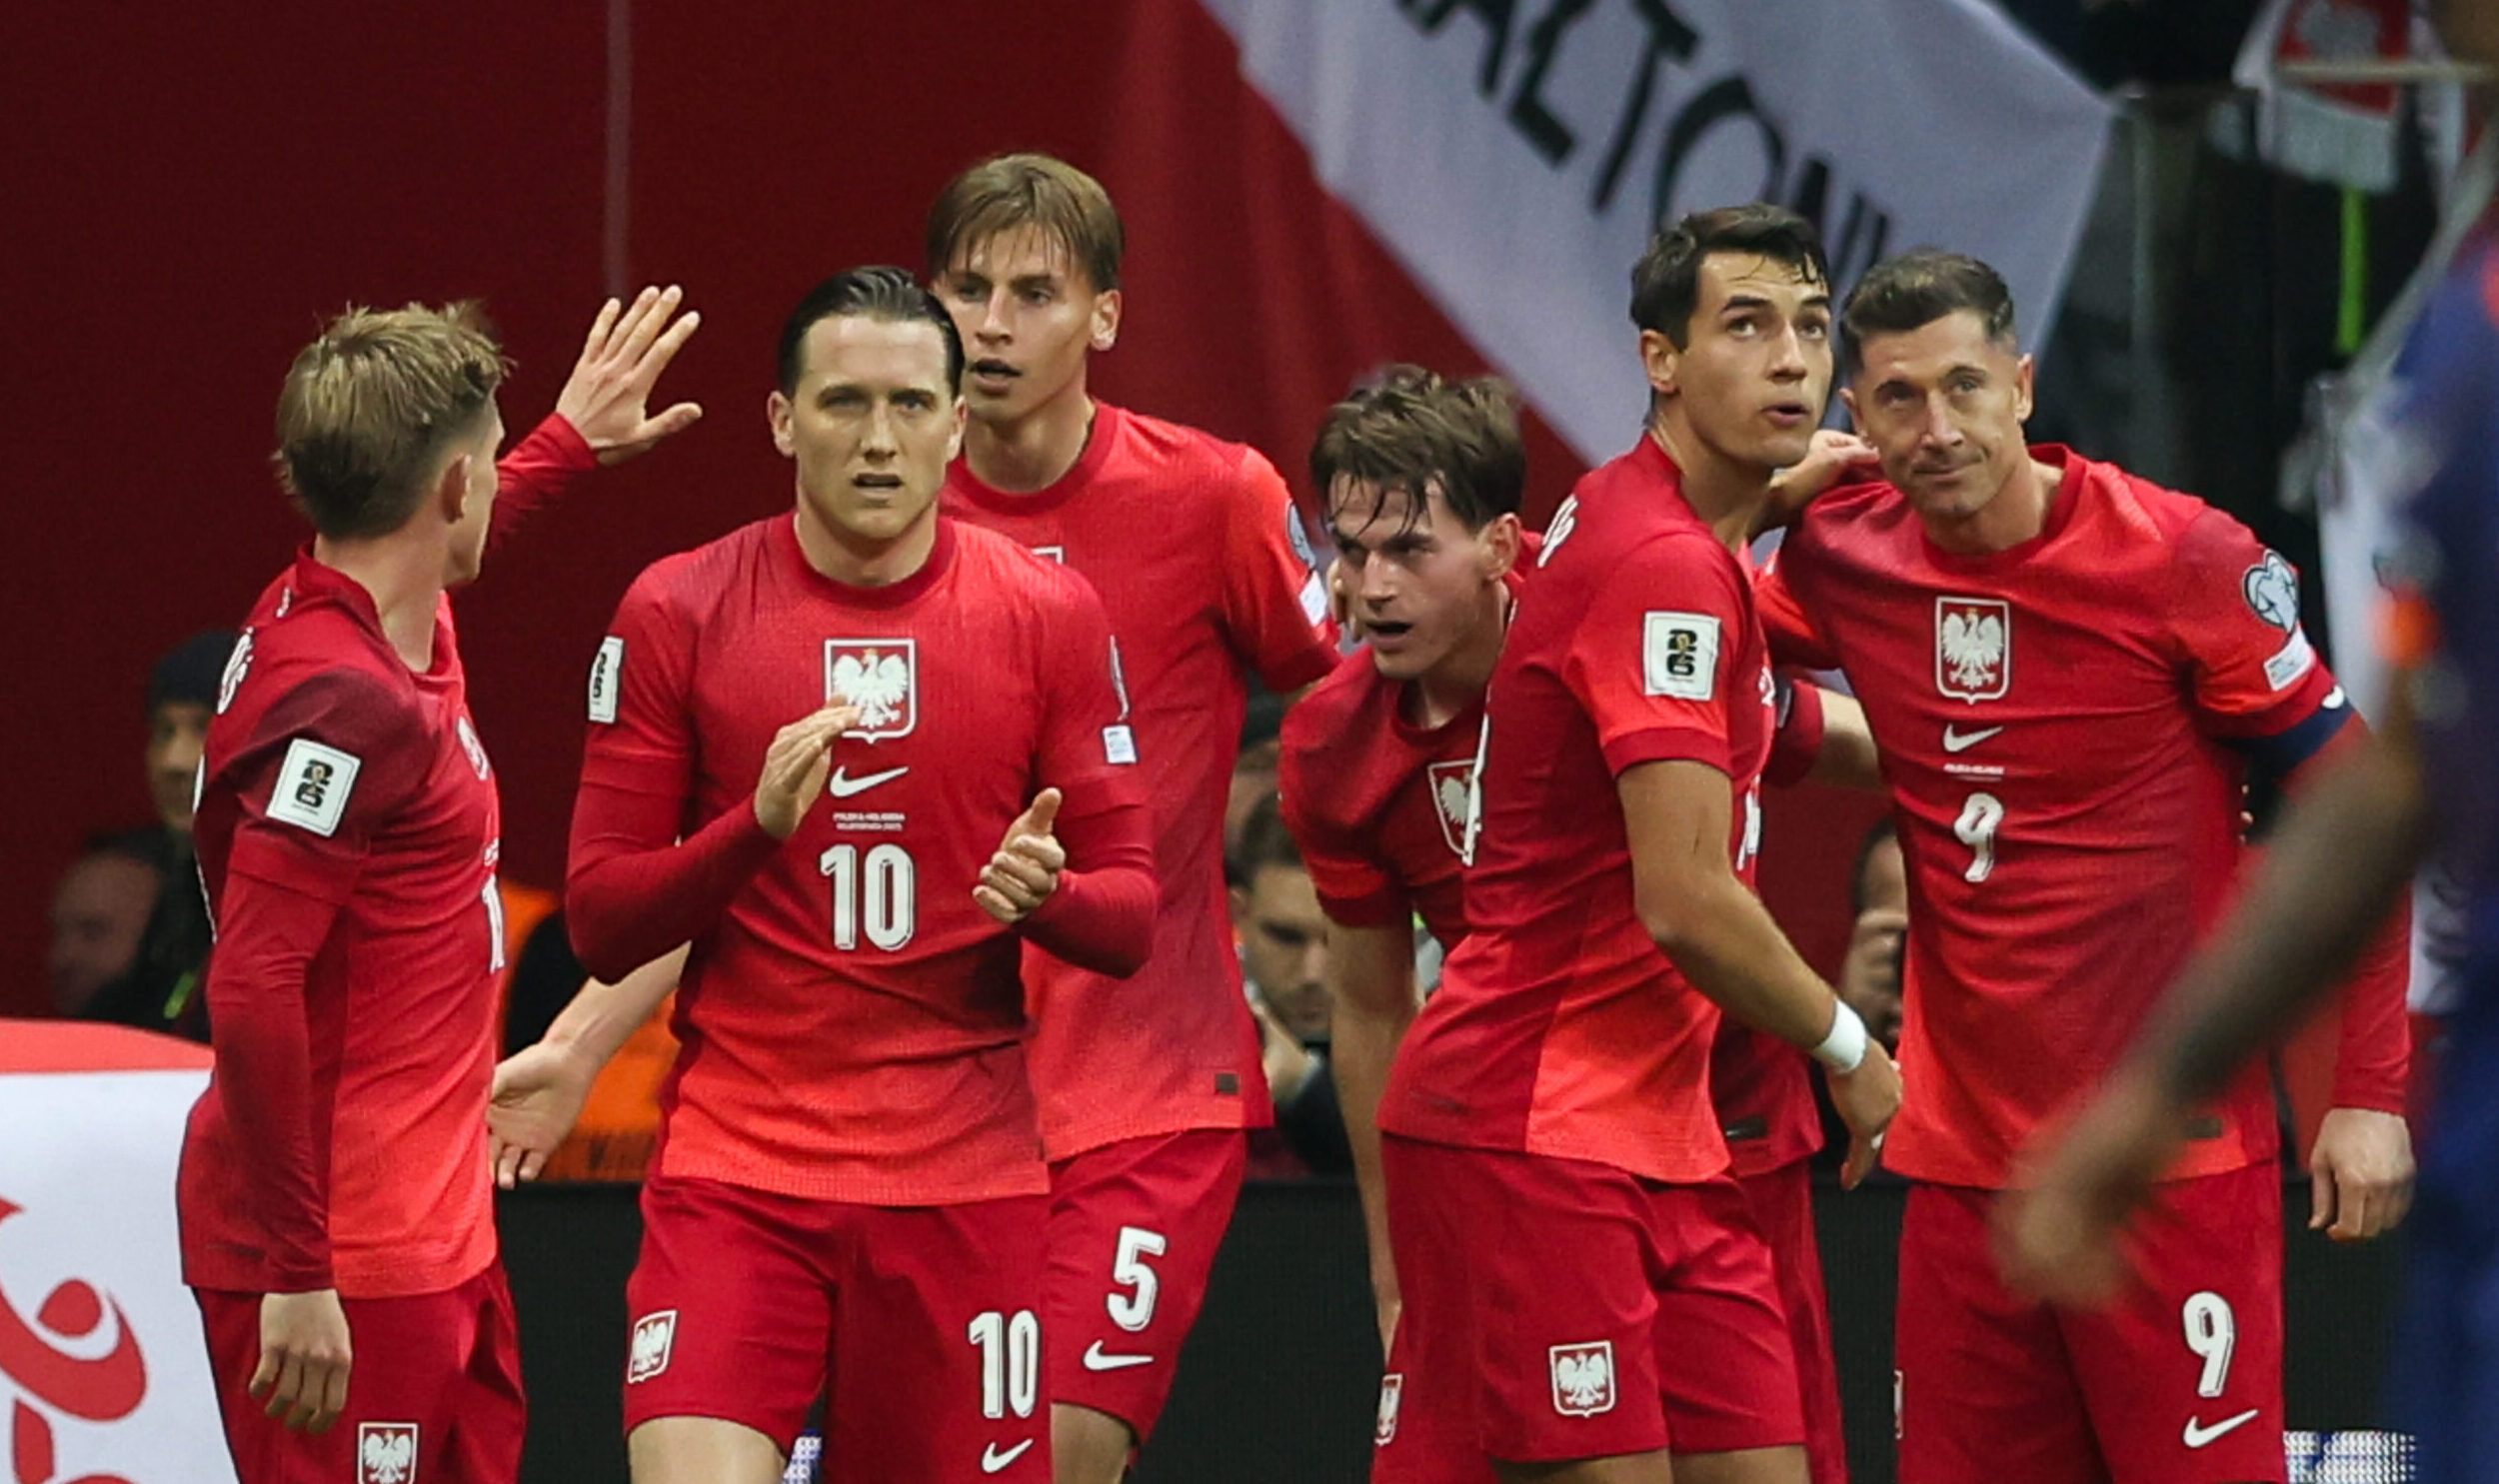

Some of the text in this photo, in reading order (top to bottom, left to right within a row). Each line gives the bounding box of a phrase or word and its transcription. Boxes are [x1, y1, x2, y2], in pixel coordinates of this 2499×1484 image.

[1953, 791, 2004, 882] 9
[820, 843, 915, 952] 10
[1107, 1225, 1167, 1332] 5
[969, 1309, 1040, 1419] 10
[2182, 1290, 2236, 1398] 9
